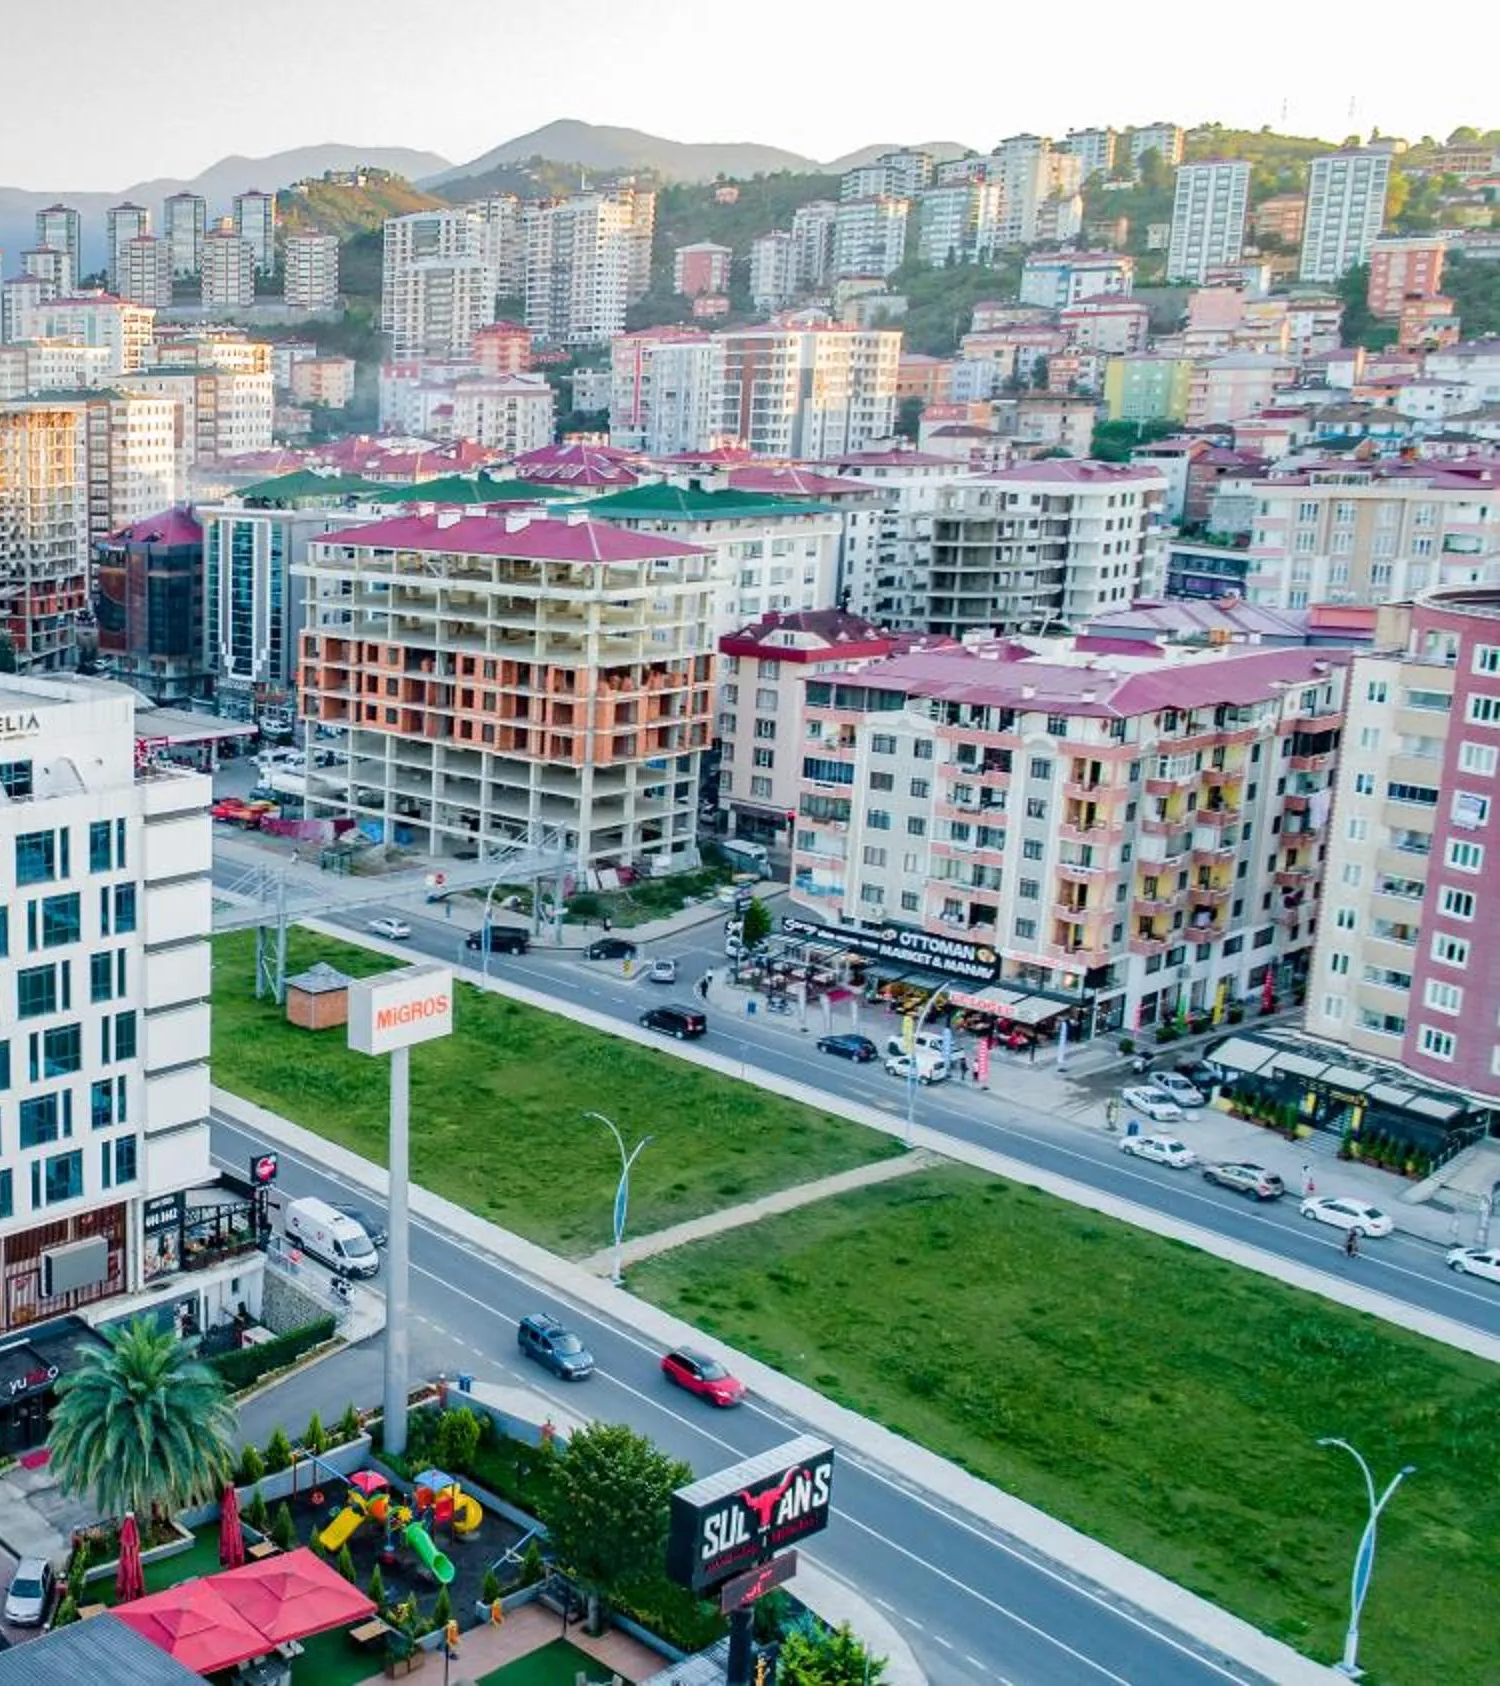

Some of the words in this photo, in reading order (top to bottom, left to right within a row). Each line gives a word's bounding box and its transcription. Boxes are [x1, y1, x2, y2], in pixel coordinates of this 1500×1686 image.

[879, 944, 933, 965] MARKET
[943, 960, 995, 980] MANAV
[899, 932, 975, 961] OTTOMAN
[701, 1463, 832, 1560] SULTANS
